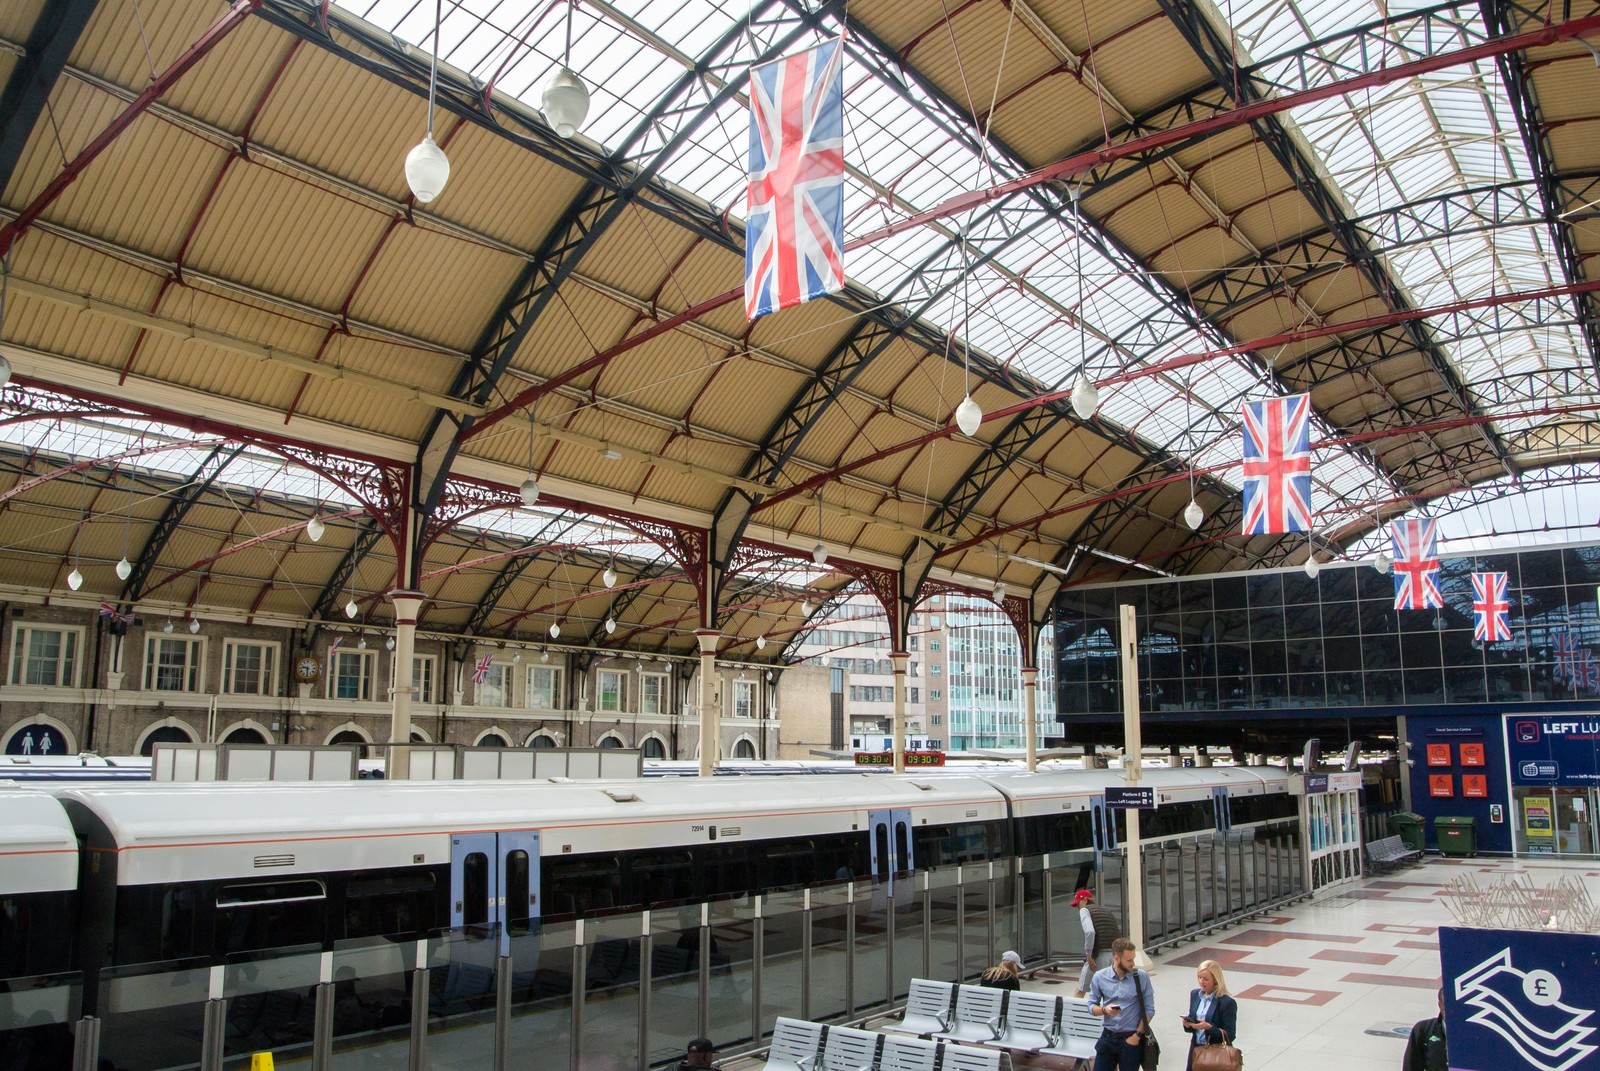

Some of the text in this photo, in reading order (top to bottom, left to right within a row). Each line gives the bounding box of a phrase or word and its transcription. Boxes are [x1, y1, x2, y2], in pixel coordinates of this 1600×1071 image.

[1543, 723, 1600, 734] LEFT LU
[859, 755, 881, 763] 09:30
[908, 755, 931, 763] 09:30
